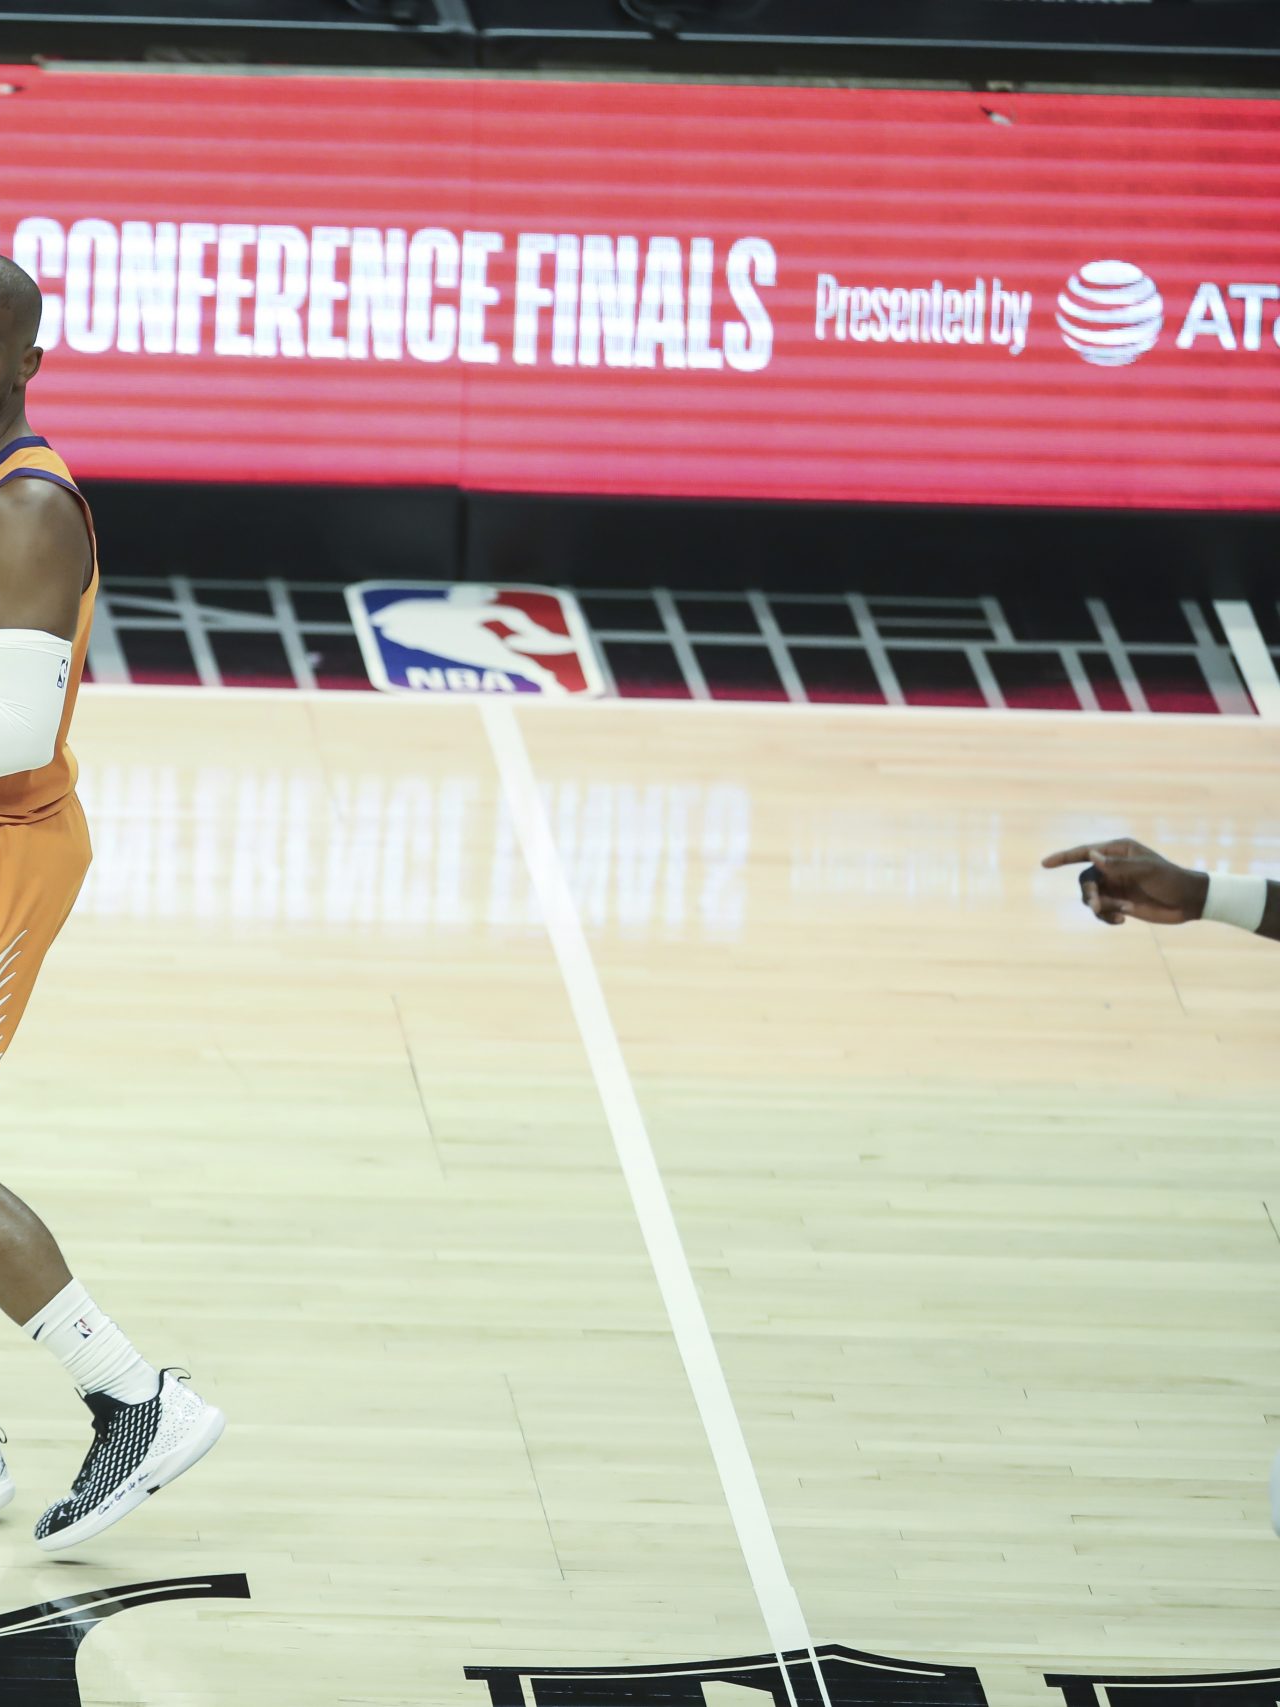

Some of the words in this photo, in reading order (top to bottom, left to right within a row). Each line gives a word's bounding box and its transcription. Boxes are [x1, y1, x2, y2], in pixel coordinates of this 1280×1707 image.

[12, 216, 503, 364] CONFERENCE
[512, 231, 777, 372] FINALS
[815, 273, 984, 344] Presented
[990, 277, 1032, 355] by
[1175, 282, 1280, 351] AT
[404, 666, 516, 692] NBA
